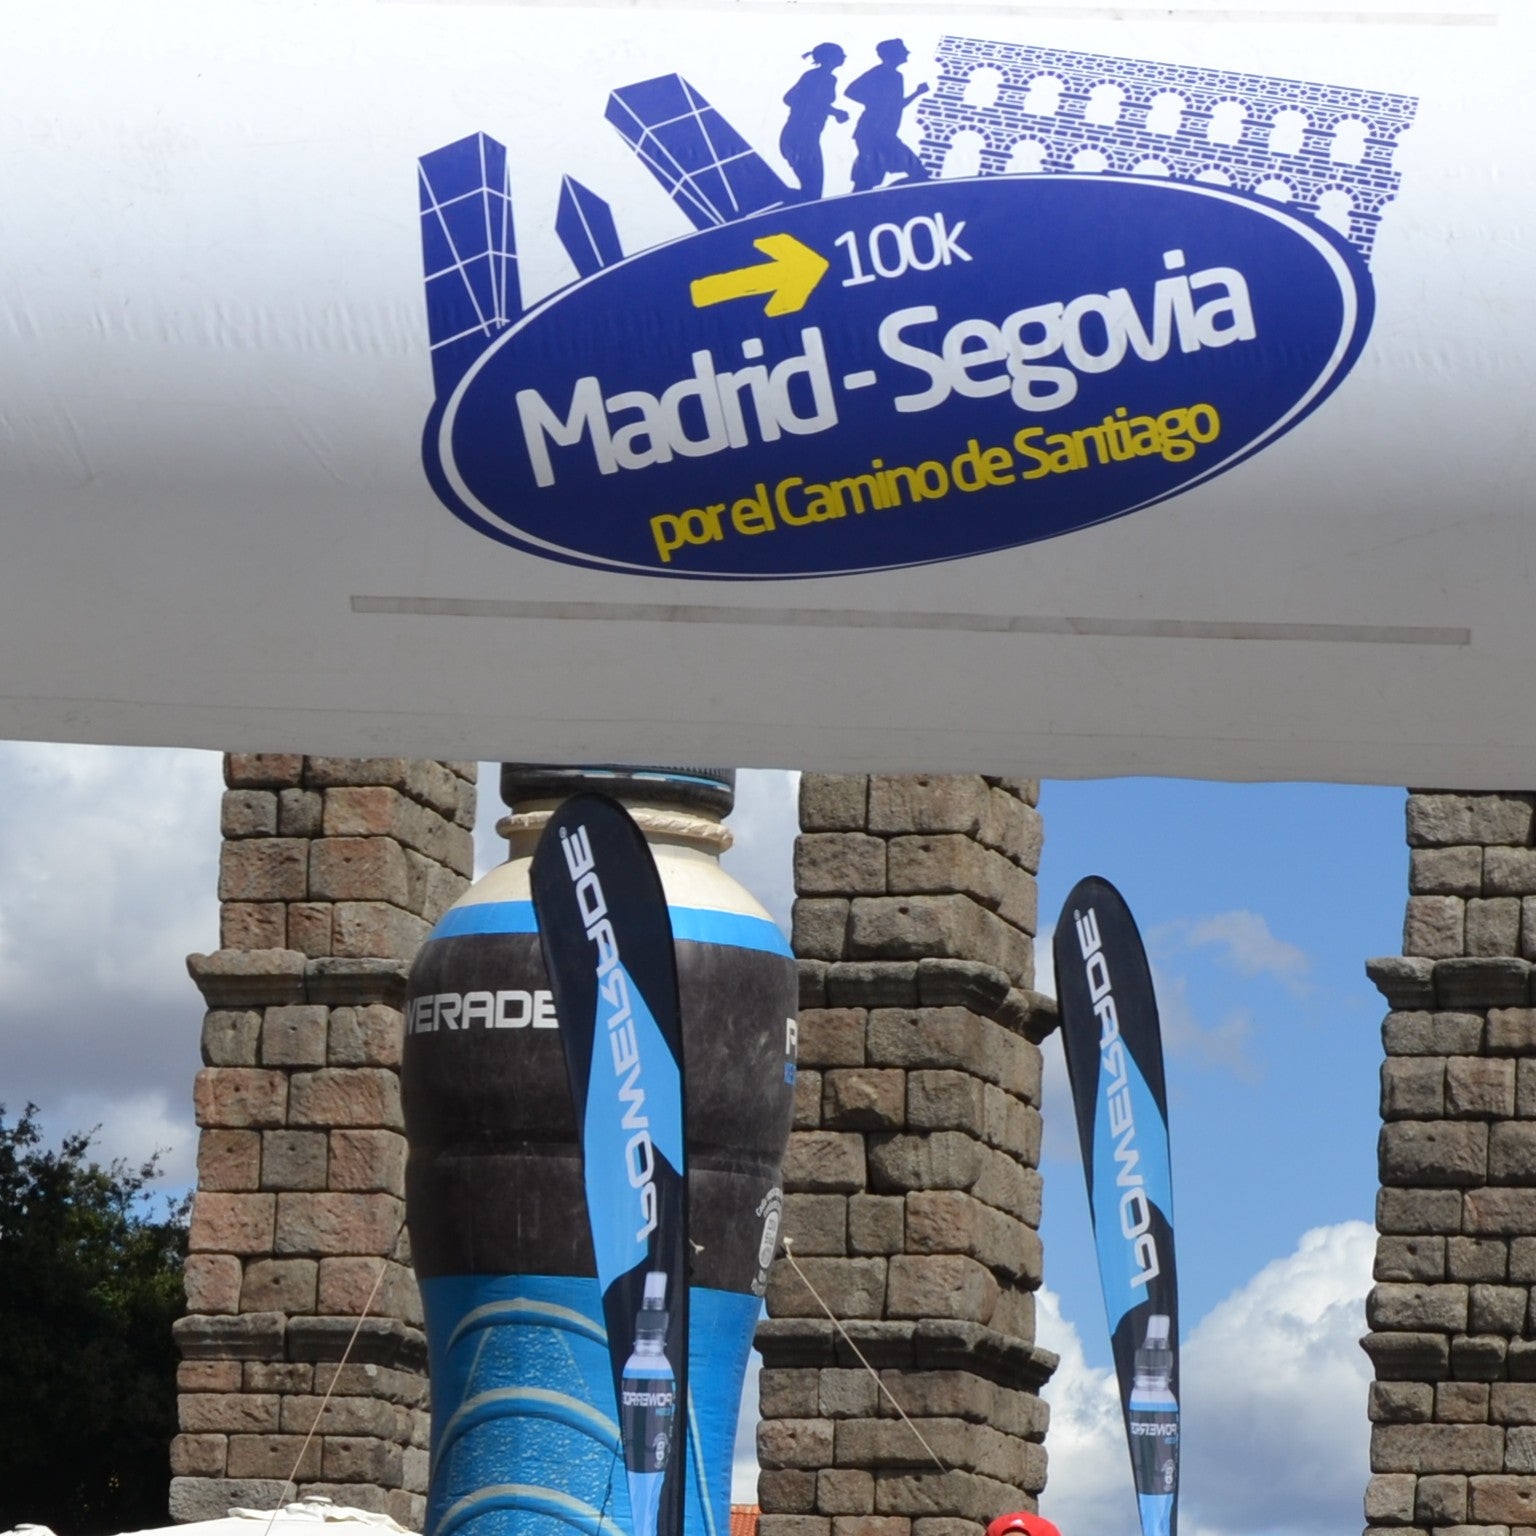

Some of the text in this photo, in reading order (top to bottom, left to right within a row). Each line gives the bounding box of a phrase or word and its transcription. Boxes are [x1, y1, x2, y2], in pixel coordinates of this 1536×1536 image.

[832, 211, 972, 288] 100k
[649, 402, 1221, 562] por el Camino de Santiago
